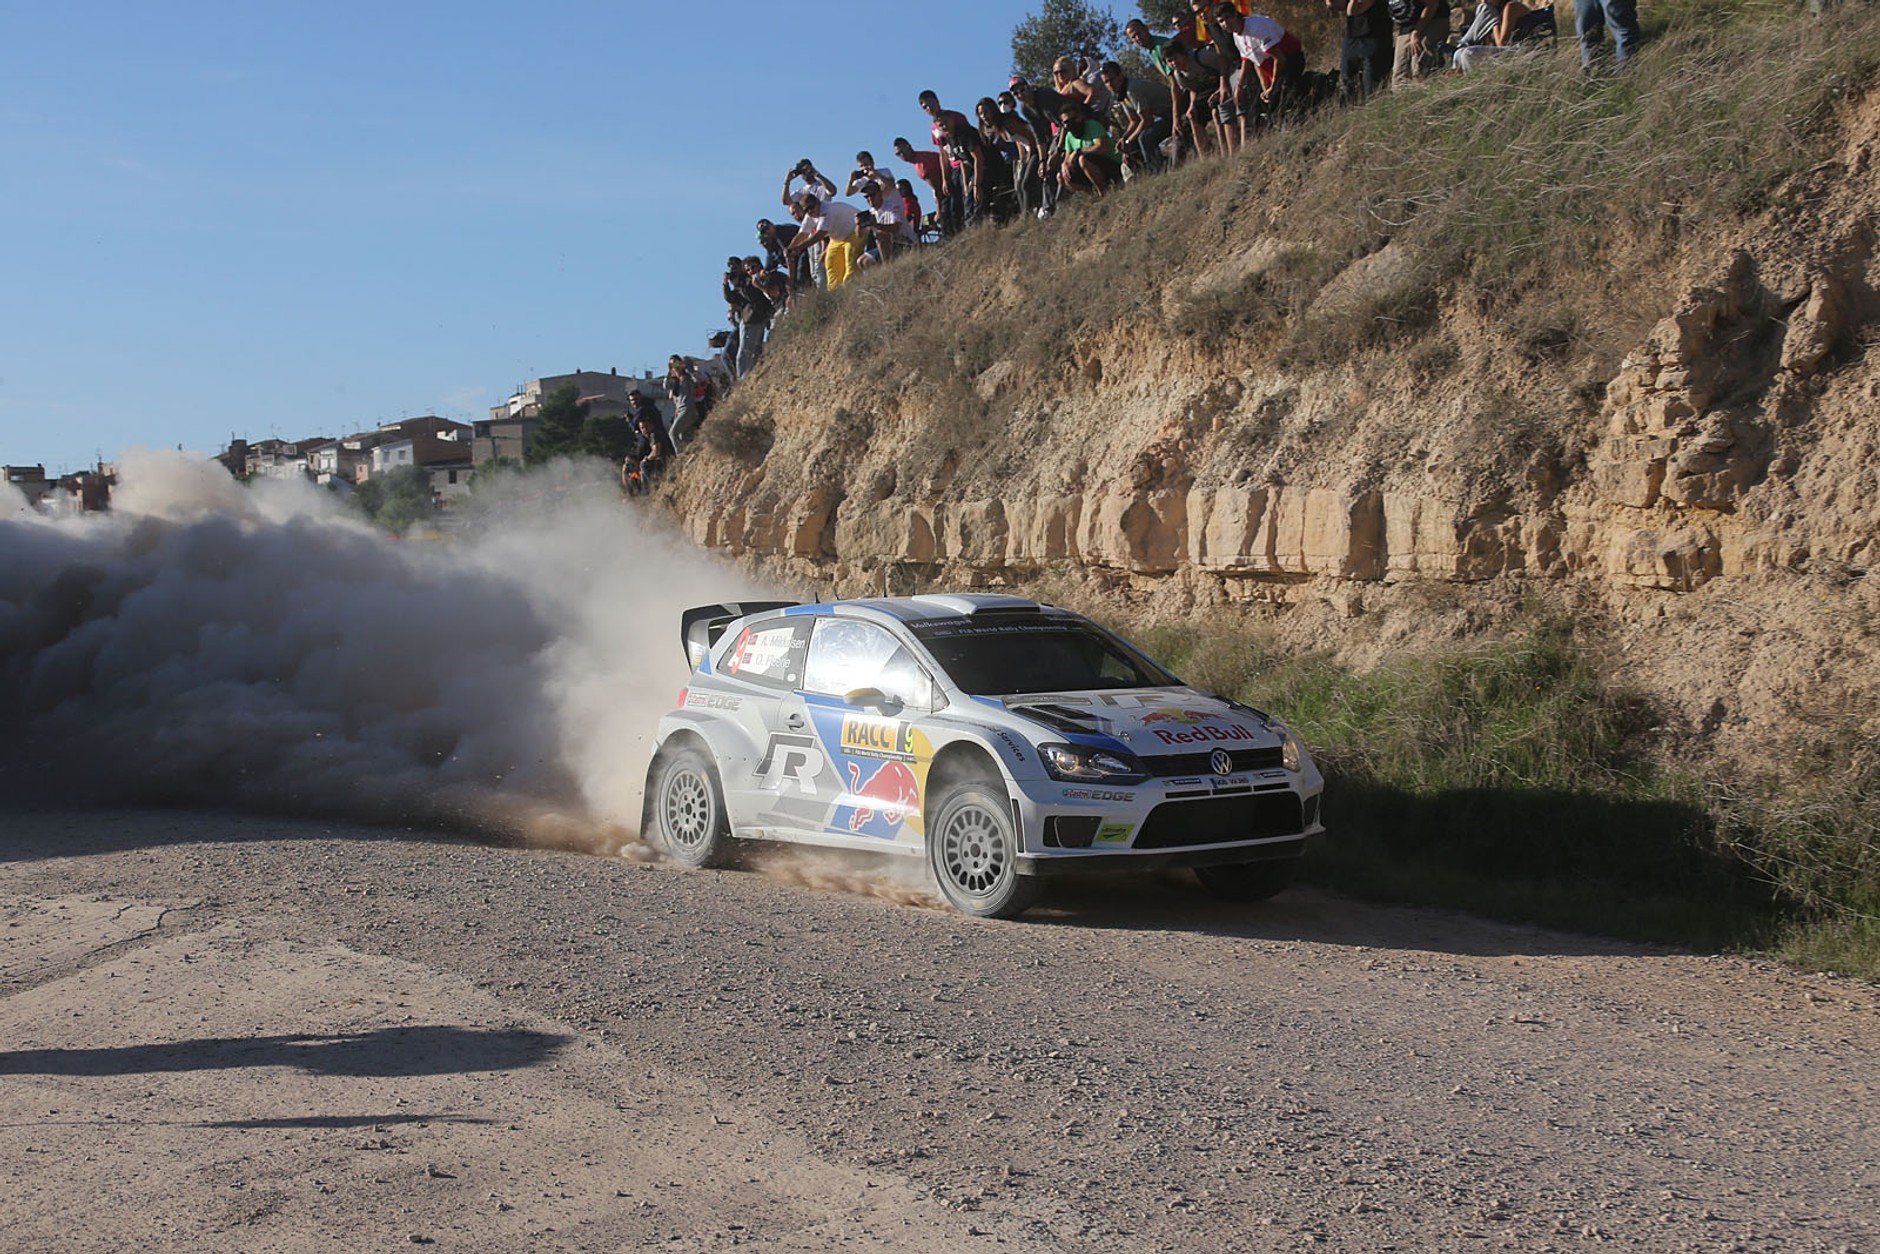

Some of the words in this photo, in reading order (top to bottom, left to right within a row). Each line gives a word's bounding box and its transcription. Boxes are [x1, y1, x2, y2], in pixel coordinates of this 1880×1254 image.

[707, 694, 743, 711] EDGE
[847, 719, 891, 749] RACC
[997, 731, 1026, 762] Services
[1152, 725, 1211, 745] Red
[1203, 723, 1255, 740] Bull
[752, 730, 824, 795] R
[1091, 789, 1137, 802] EDGE
